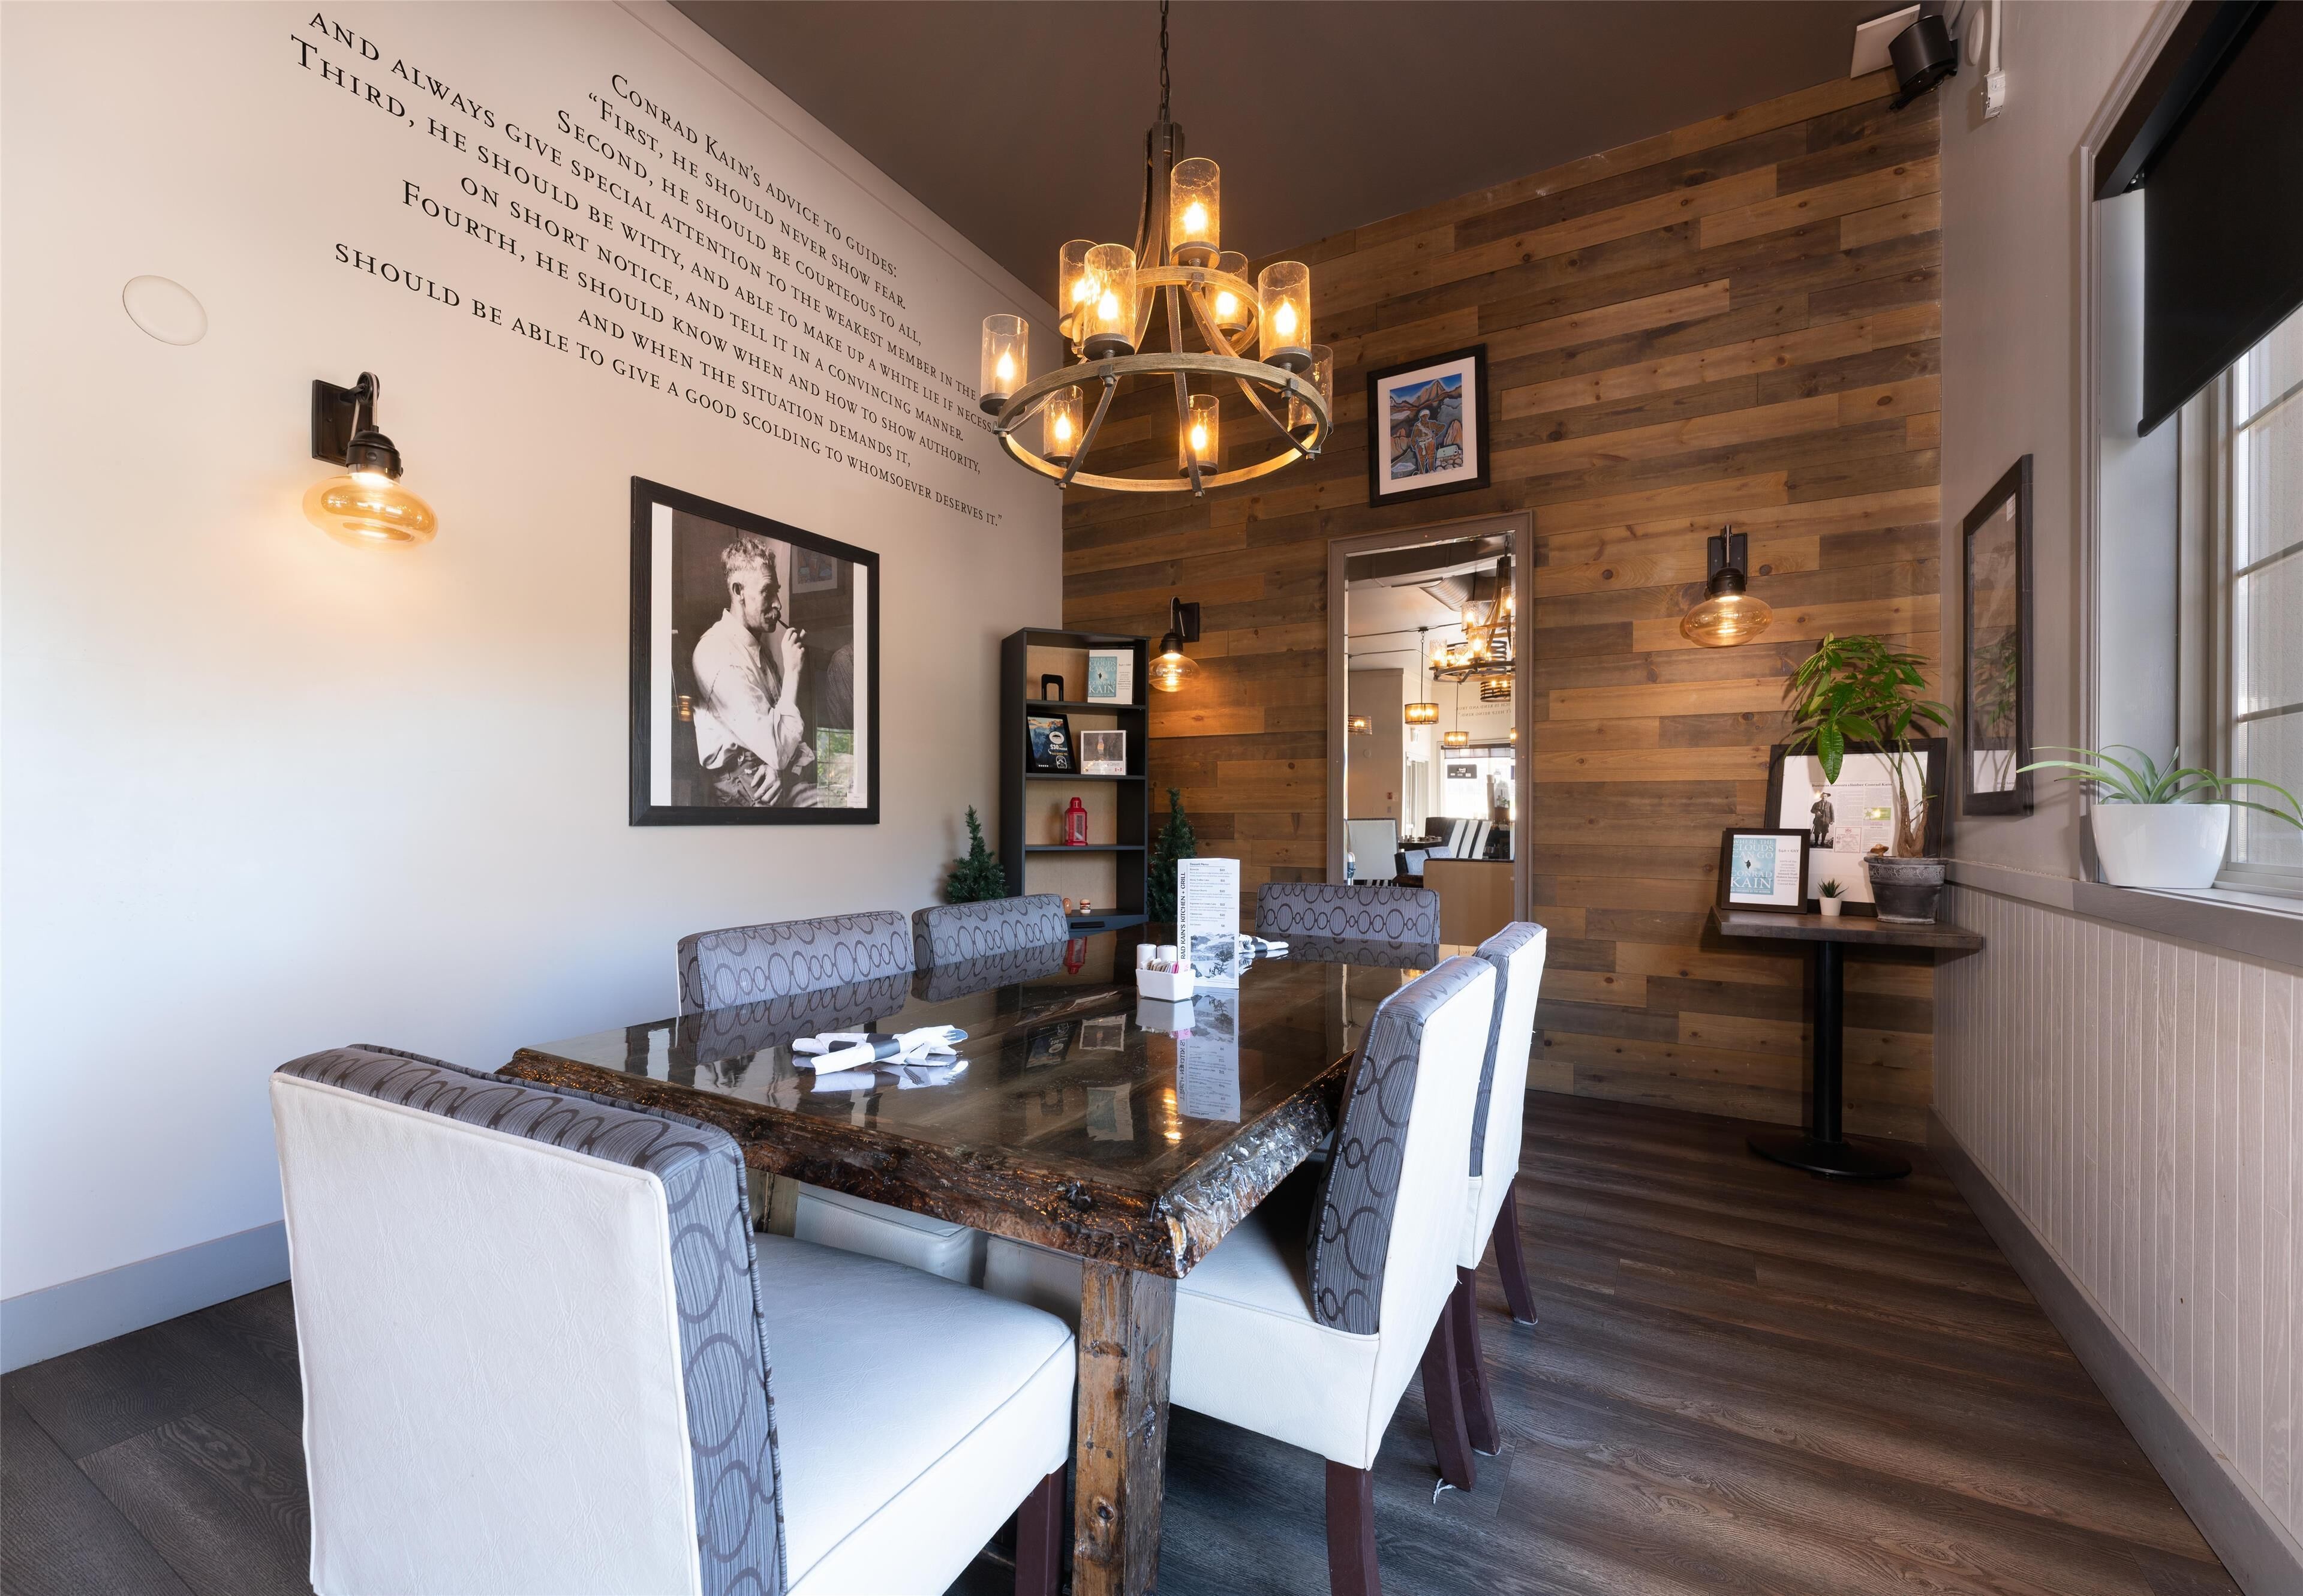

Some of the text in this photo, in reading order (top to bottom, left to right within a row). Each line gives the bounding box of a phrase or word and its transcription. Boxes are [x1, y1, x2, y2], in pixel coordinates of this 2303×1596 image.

[291, 34, 996, 435] THIRD, HE SHOULD BE WITTY, AND ABLE TO MAKE UP A WHITE LIE IF NECESS
[308, 12, 976, 401] AND ALWAYS GIVE SPECIAL ATTENTION TO THE WEAKEST MEMBER IN THE
[558, 110, 921, 347] SECOND, HE SHOULD BE COURTEOUS TO ALL,
[612, 74, 697, 144] CONRAD
[765, 182, 819, 227] ADVICE
[823, 219, 841, 241] TO
[846, 236, 897, 278] GUIDES:
[672, 150, 698, 179] HE
[705, 172, 774, 225] SHOULD
[780, 220, 827, 260] NEVER
[832, 254, 870, 286] SHOW
[874, 280, 906, 309] FEAR.
[335, 243, 460, 306] SHOULD
[471, 299, 502, 326] BE
[511, 317, 569, 353] ABLE
[576, 341, 604, 366] TO
[612, 359, 660, 390] GIVE
[667, 381, 679, 397] A
[686, 389, 736, 419] GOOD
[743, 411, 821, 454] SCOLDING
[825, 445, 843, 463] TO
[846, 455, 932, 500] WHOMSOEVER
[935, 491, 983, 521] DESERVES
[402, 179, 980, 475] FOURTH, HE SHOULD KNOW WHEN AND HOW TO SHOW AUTHORITY,
[461, 177, 964, 441] ON SHORT NOTICE, AND TELL IT IN A CONVINCING MANNER.
[578, 309, 910, 467] AND WHEN THE SITUATION DEMANDS IT,
[1731, 877, 1772, 888] KAIN
